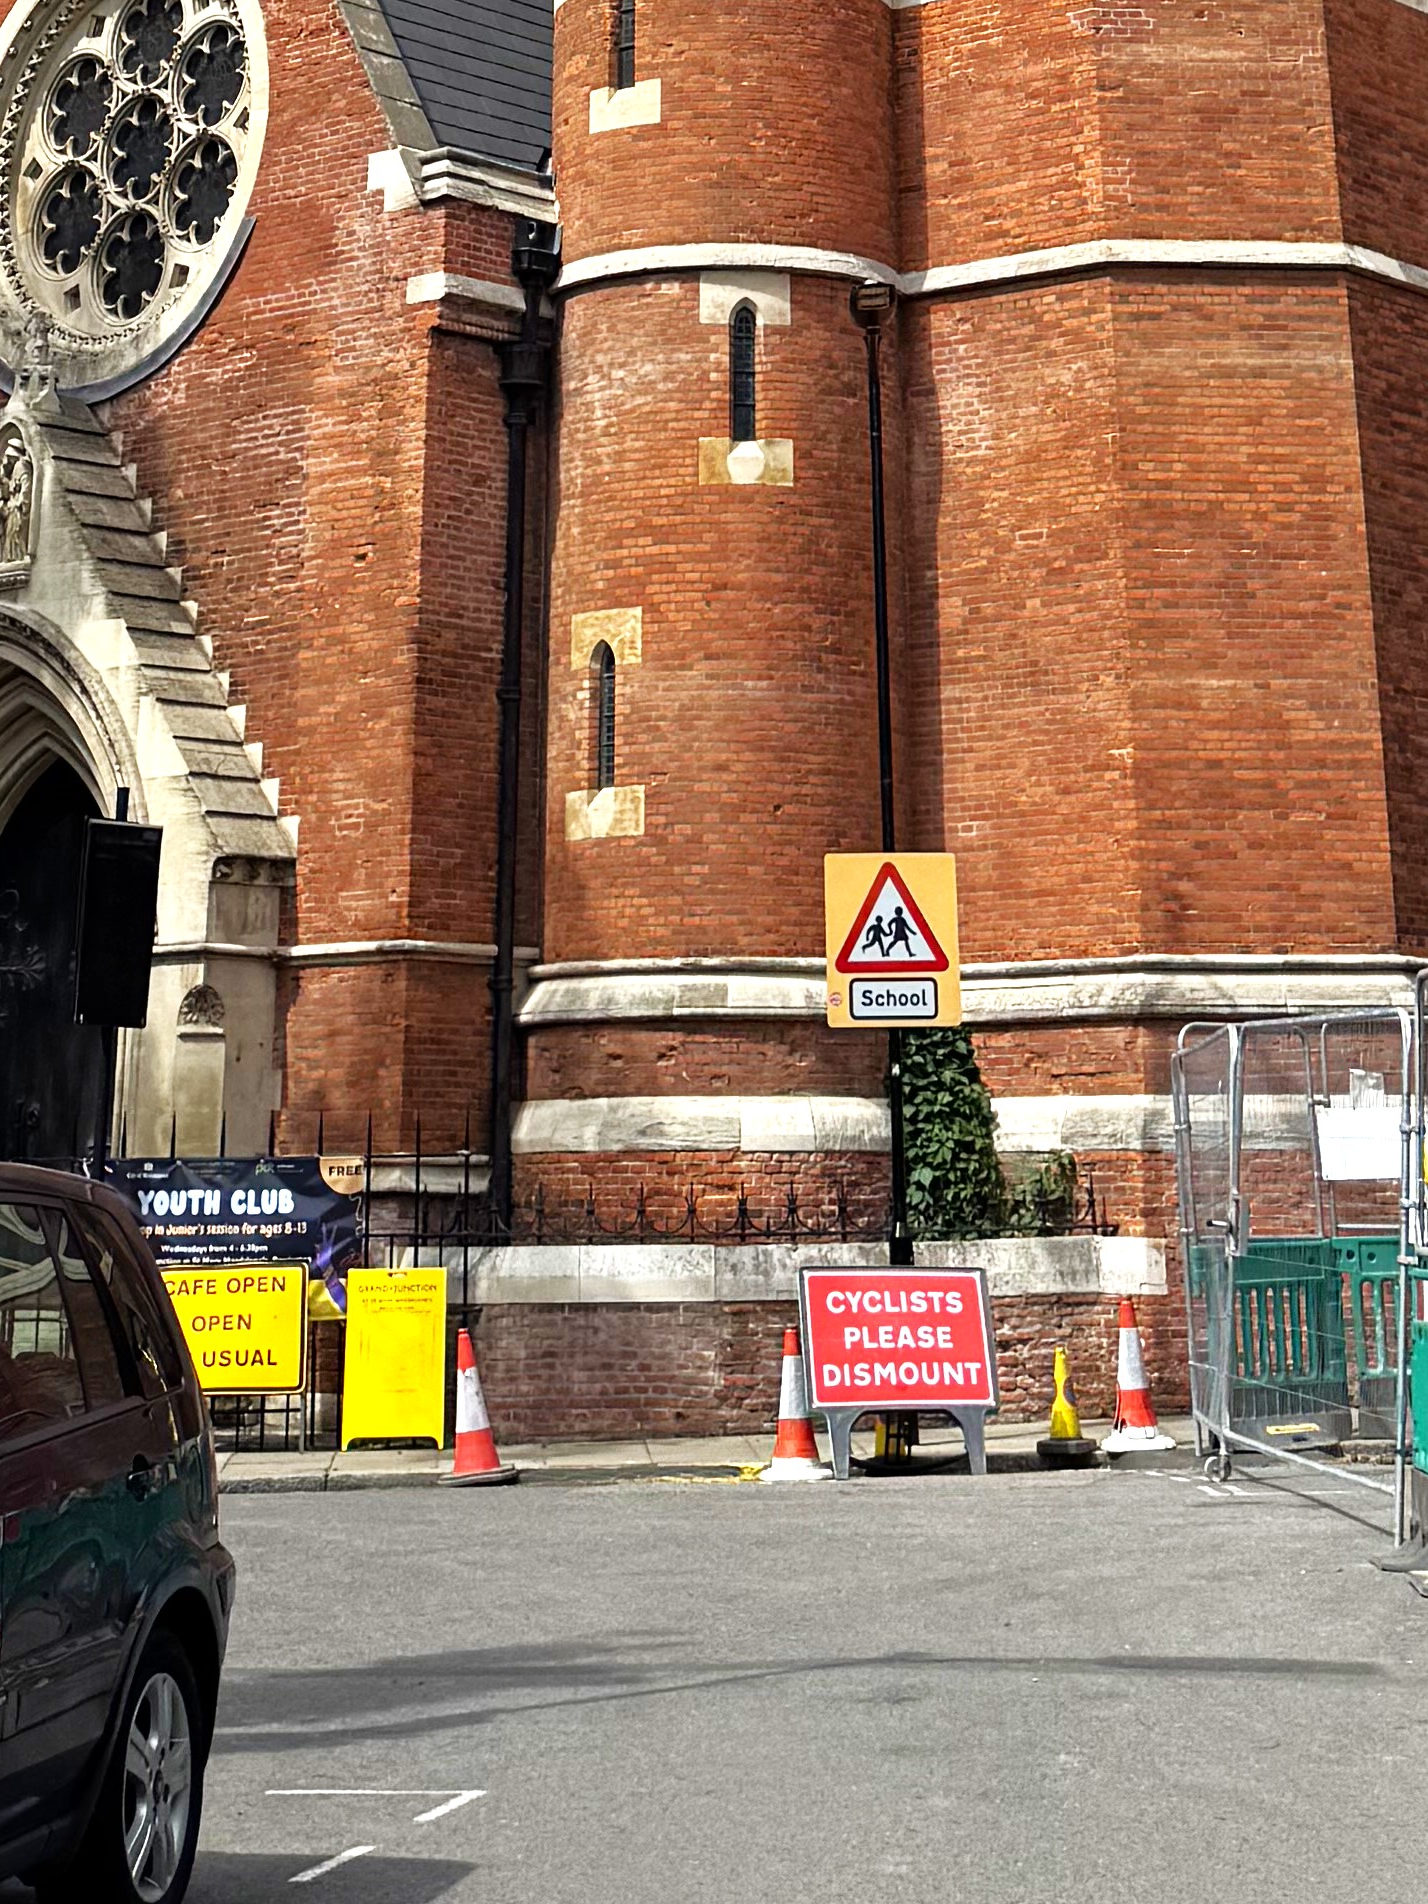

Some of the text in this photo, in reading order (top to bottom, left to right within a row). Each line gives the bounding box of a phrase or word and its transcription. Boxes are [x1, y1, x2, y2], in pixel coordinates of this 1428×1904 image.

[861, 989, 928, 1007] School
[328, 1164, 363, 1177] FREE
[137, 1188, 295, 1216] YOUTH CLUB
[139, 1226, 152, 1239] op
[154, 1224, 164, 1235] in
[166, 1223, 205, 1236] Junior's
[206, 1224, 240, 1235] session
[242, 1222, 258, 1234] for
[260, 1224, 283, 1238] ages
[165, 1276, 286, 1296] CAFE OPEN
[825, 1290, 964, 1314] CYCLISTS
[191, 1313, 252, 1332] OPEN
[843, 1326, 954, 1350] PLEASE
[202, 1348, 278, 1367] USUAL
[822, 1362, 982, 1387] DISMOUNT
